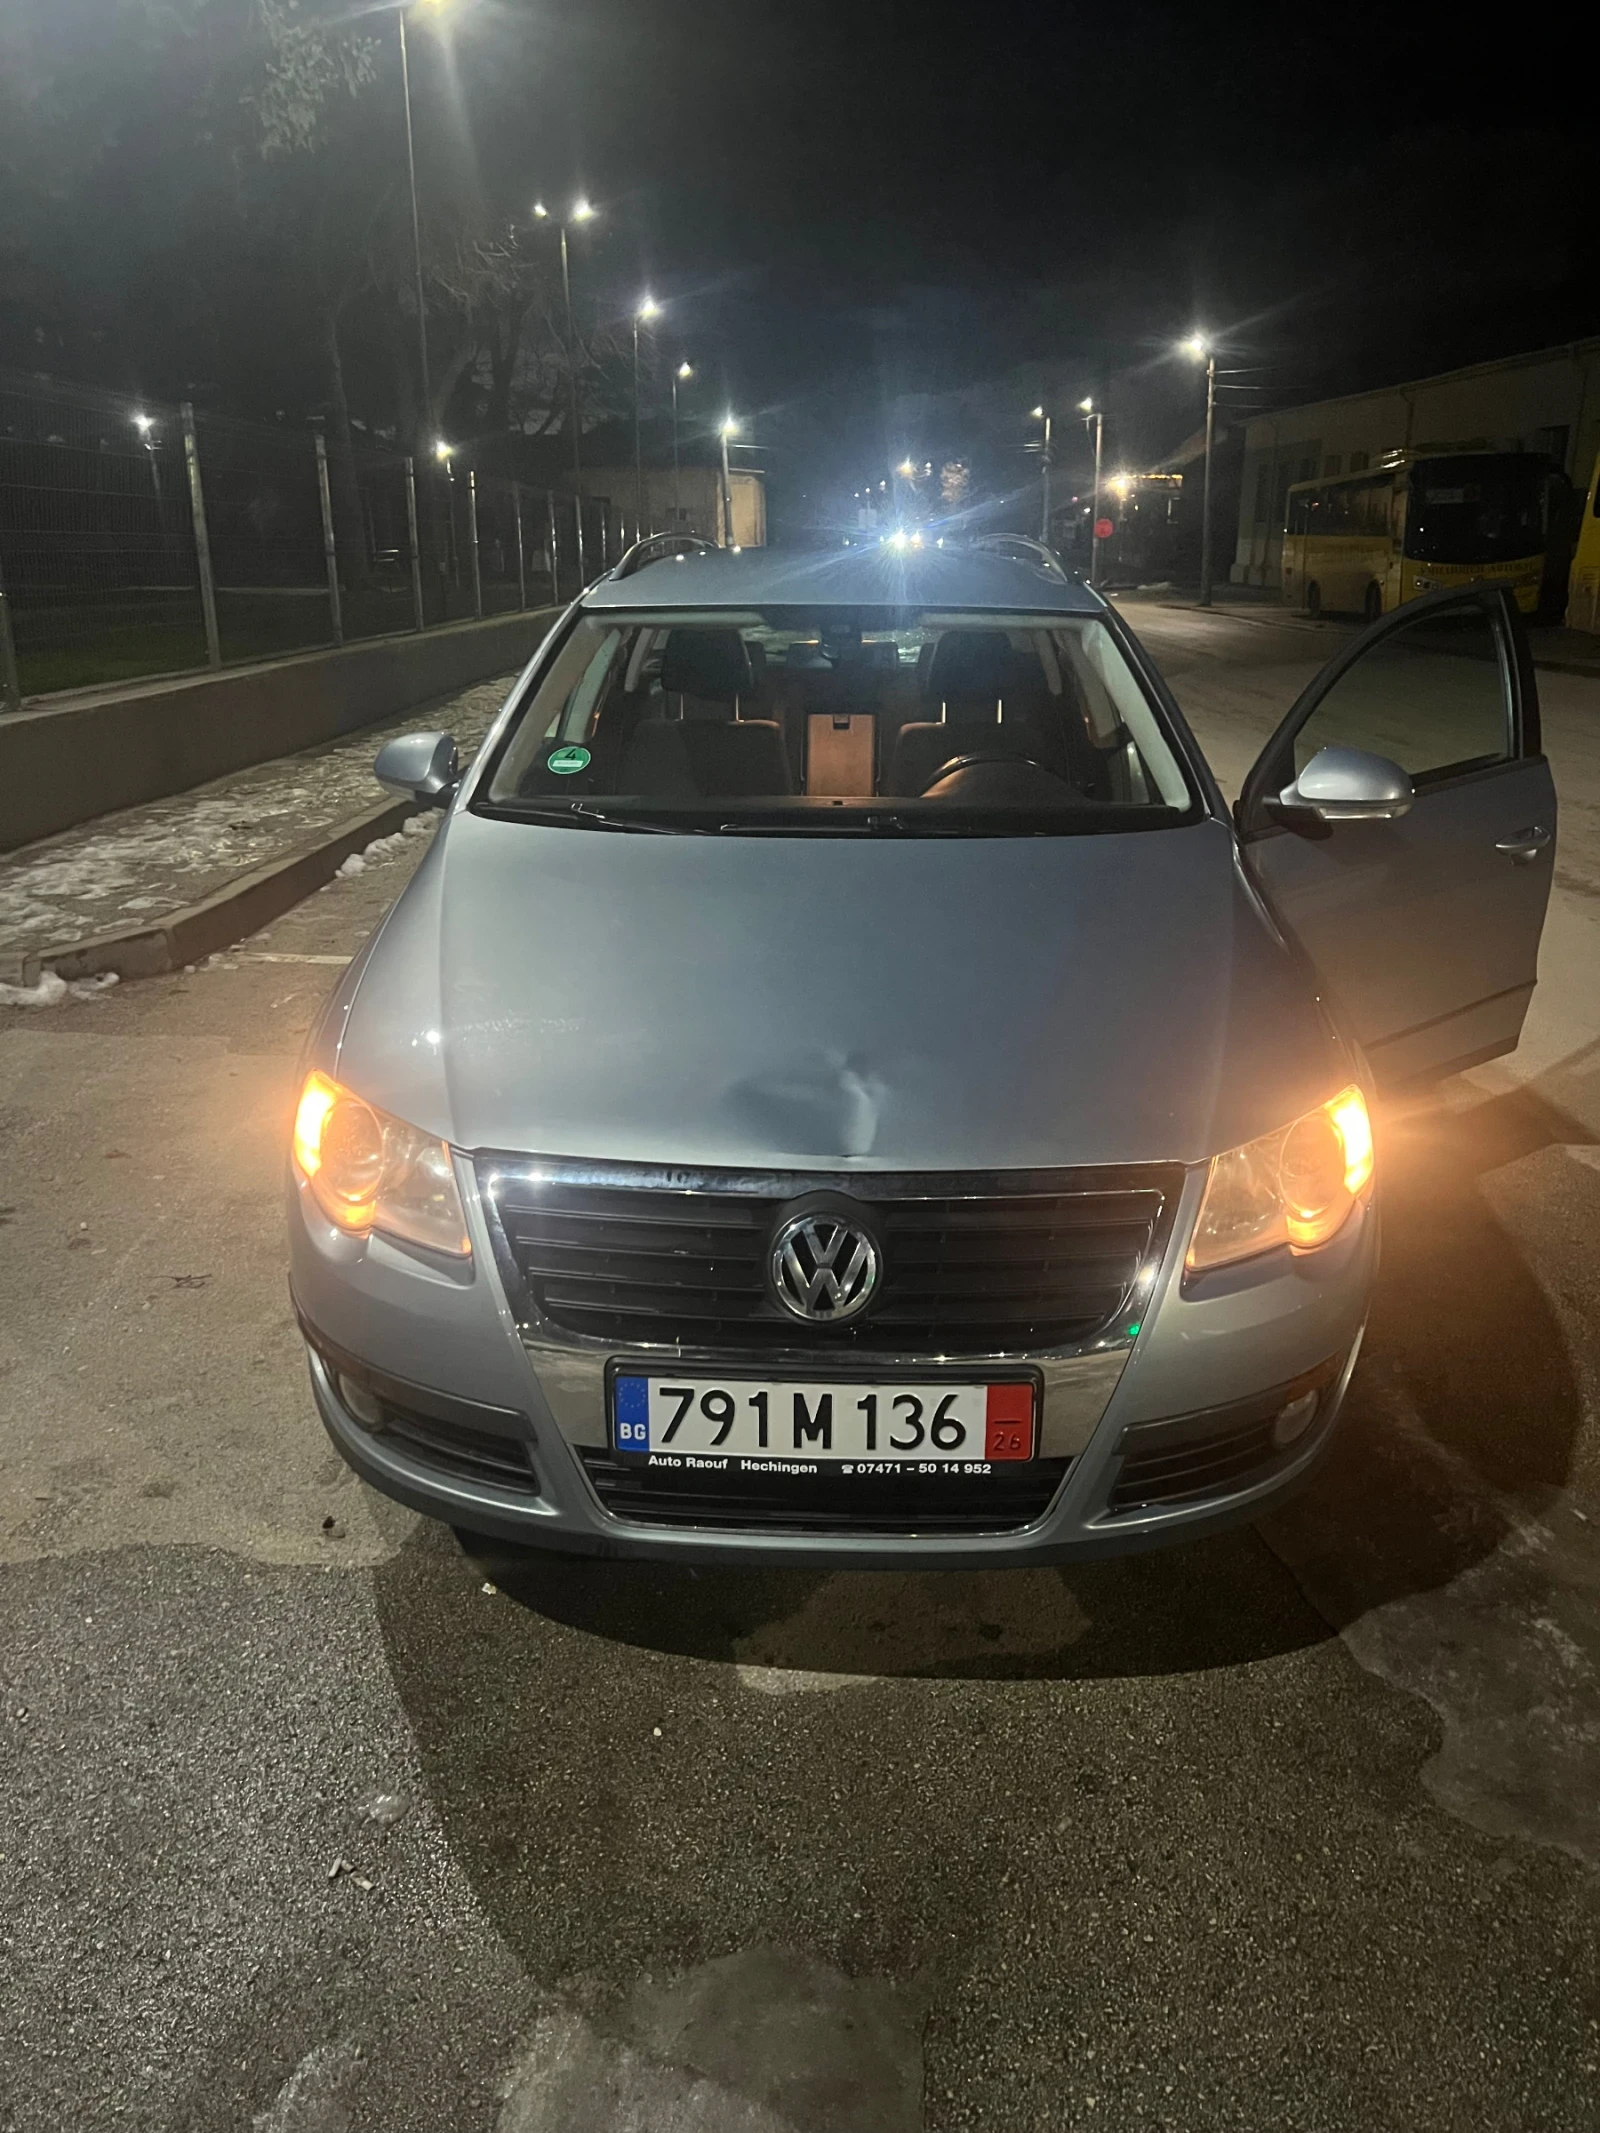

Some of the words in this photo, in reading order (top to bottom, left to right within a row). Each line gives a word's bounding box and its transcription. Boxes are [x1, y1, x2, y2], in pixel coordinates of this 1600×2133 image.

[564, 748, 576, 760] 4
[659, 1387, 768, 1448] 791
[793, 1392, 833, 1450] M
[857, 1393, 967, 1451] 136
[619, 1422, 646, 1440] BG
[992, 1432, 1021, 1452] 26
[648, 1455, 682, 1467] Auto
[686, 1457, 728, 1469] Raouf
[741, 1459, 818, 1475] Hechingen
[857, 1463, 901, 1474] 07471
[918, 1463, 937, 1474] 50
[942, 1463, 959, 1474] 14
[964, 1463, 992, 1474] 952
